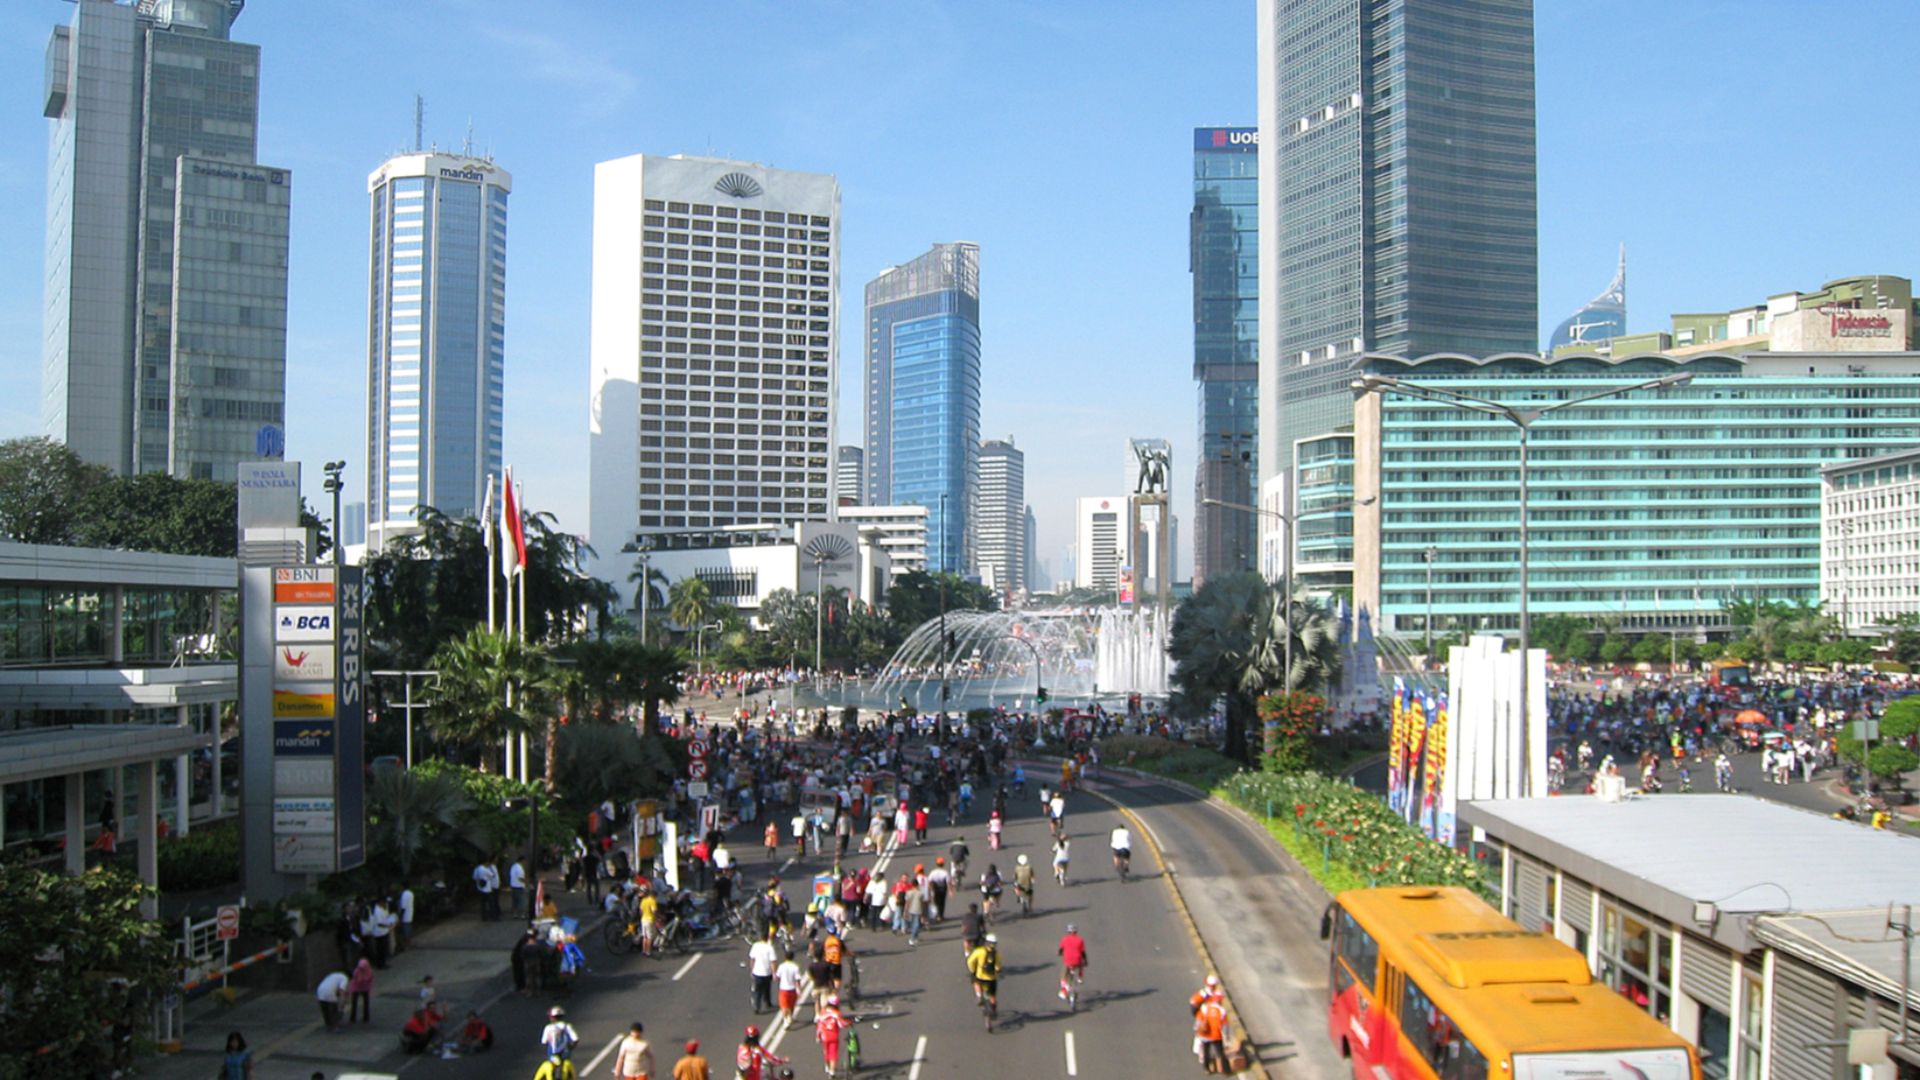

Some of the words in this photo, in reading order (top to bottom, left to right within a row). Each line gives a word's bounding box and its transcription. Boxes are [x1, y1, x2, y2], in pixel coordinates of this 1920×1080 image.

[293, 568, 319, 581] BNI
[296, 616, 330, 630] BCA
[343, 628, 359, 706] RBS
[278, 702, 323, 711] Danamon
